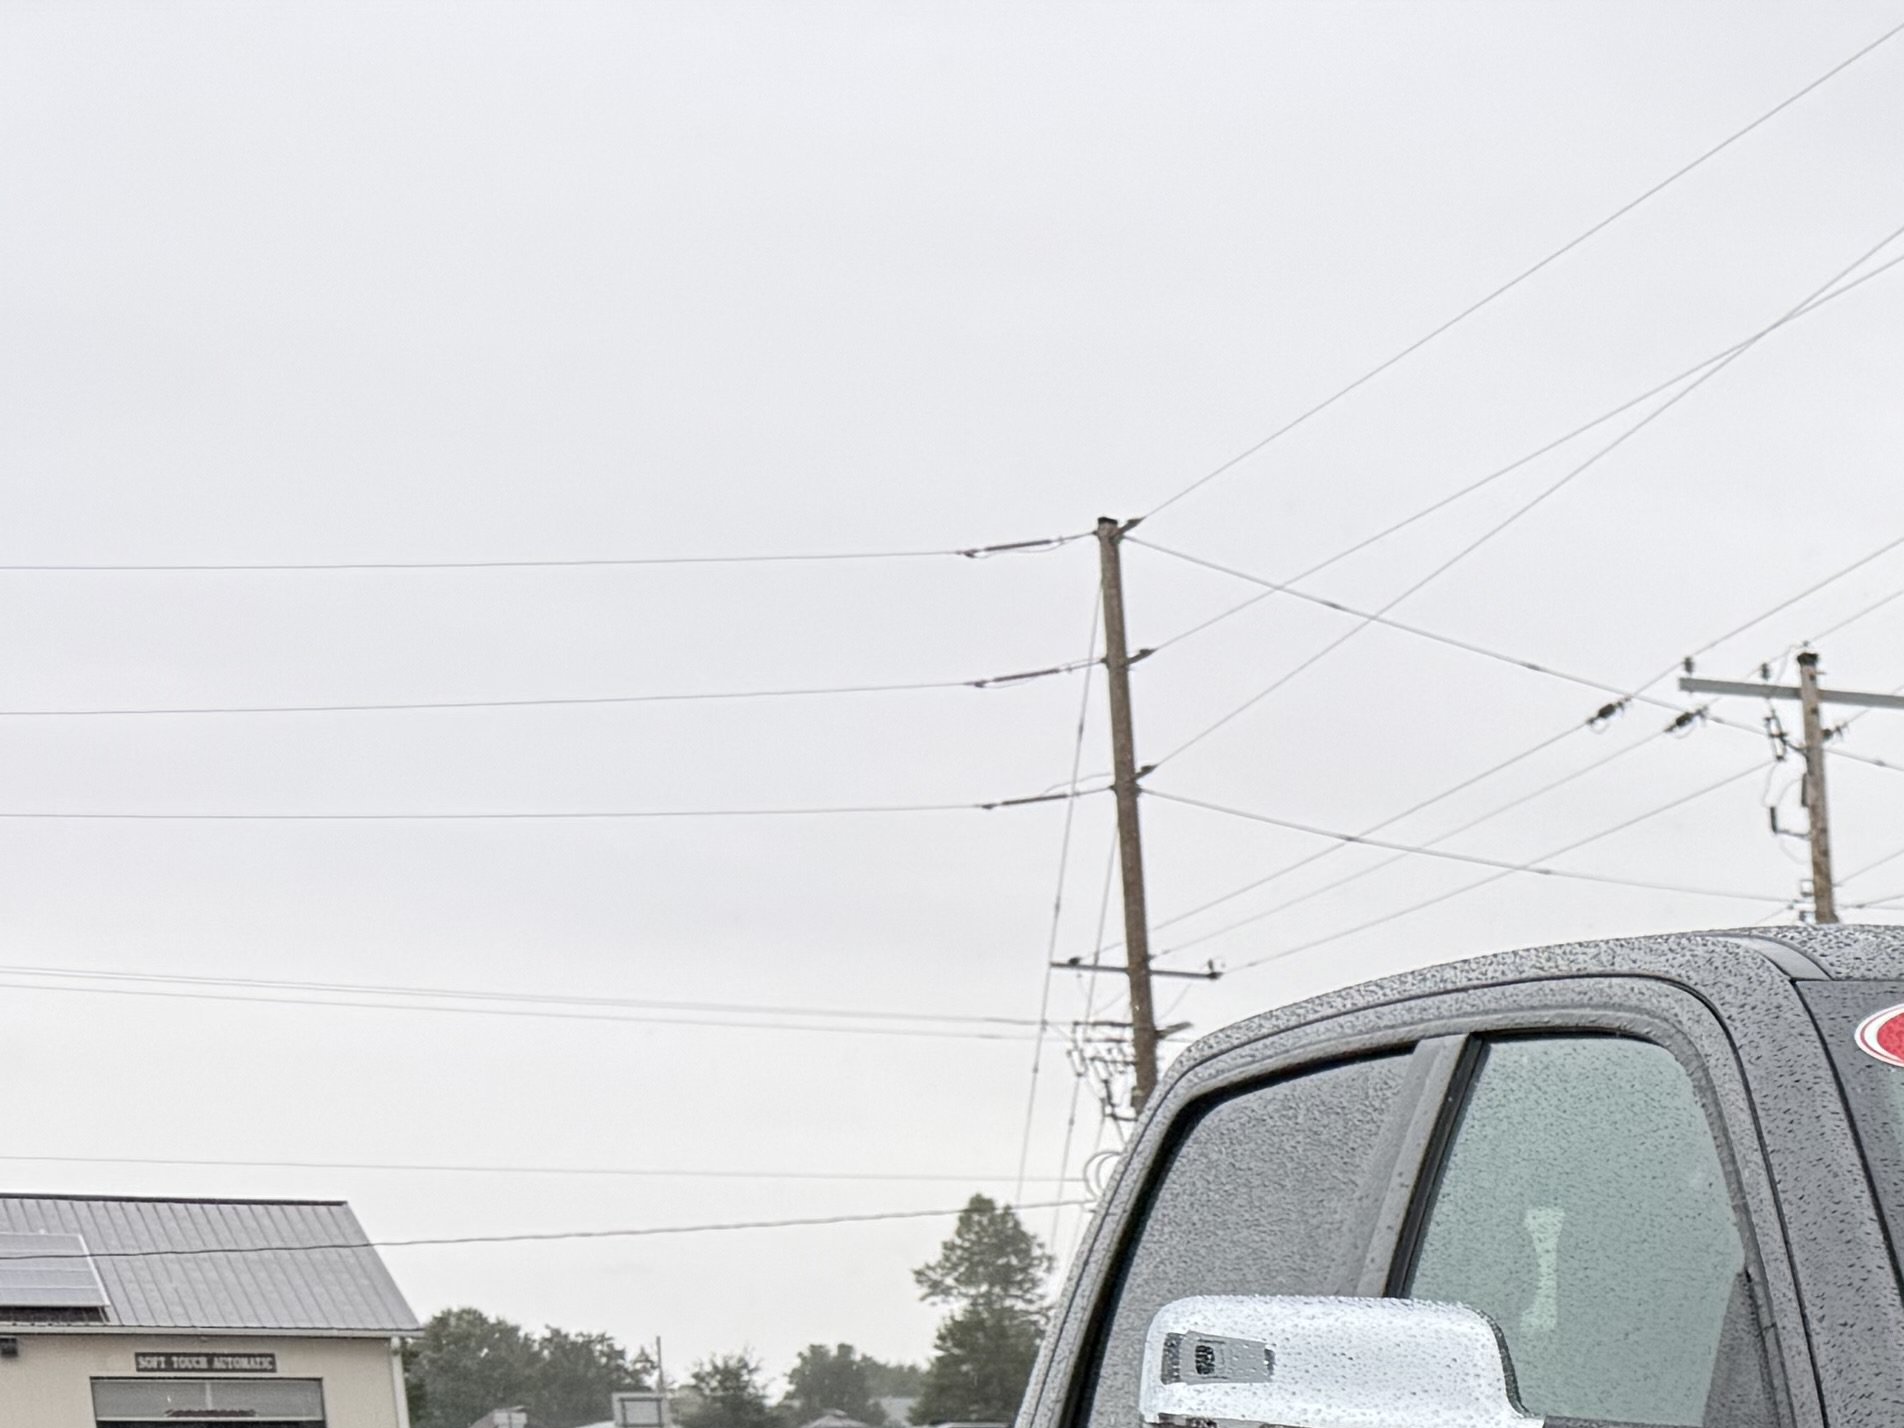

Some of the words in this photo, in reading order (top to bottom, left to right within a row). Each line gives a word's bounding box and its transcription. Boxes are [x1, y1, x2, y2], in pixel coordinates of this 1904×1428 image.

[138, 1356, 166, 1369] SOFT
[172, 1356, 208, 1369] TOUCH
[213, 1357, 273, 1370] AUTOMATIC
